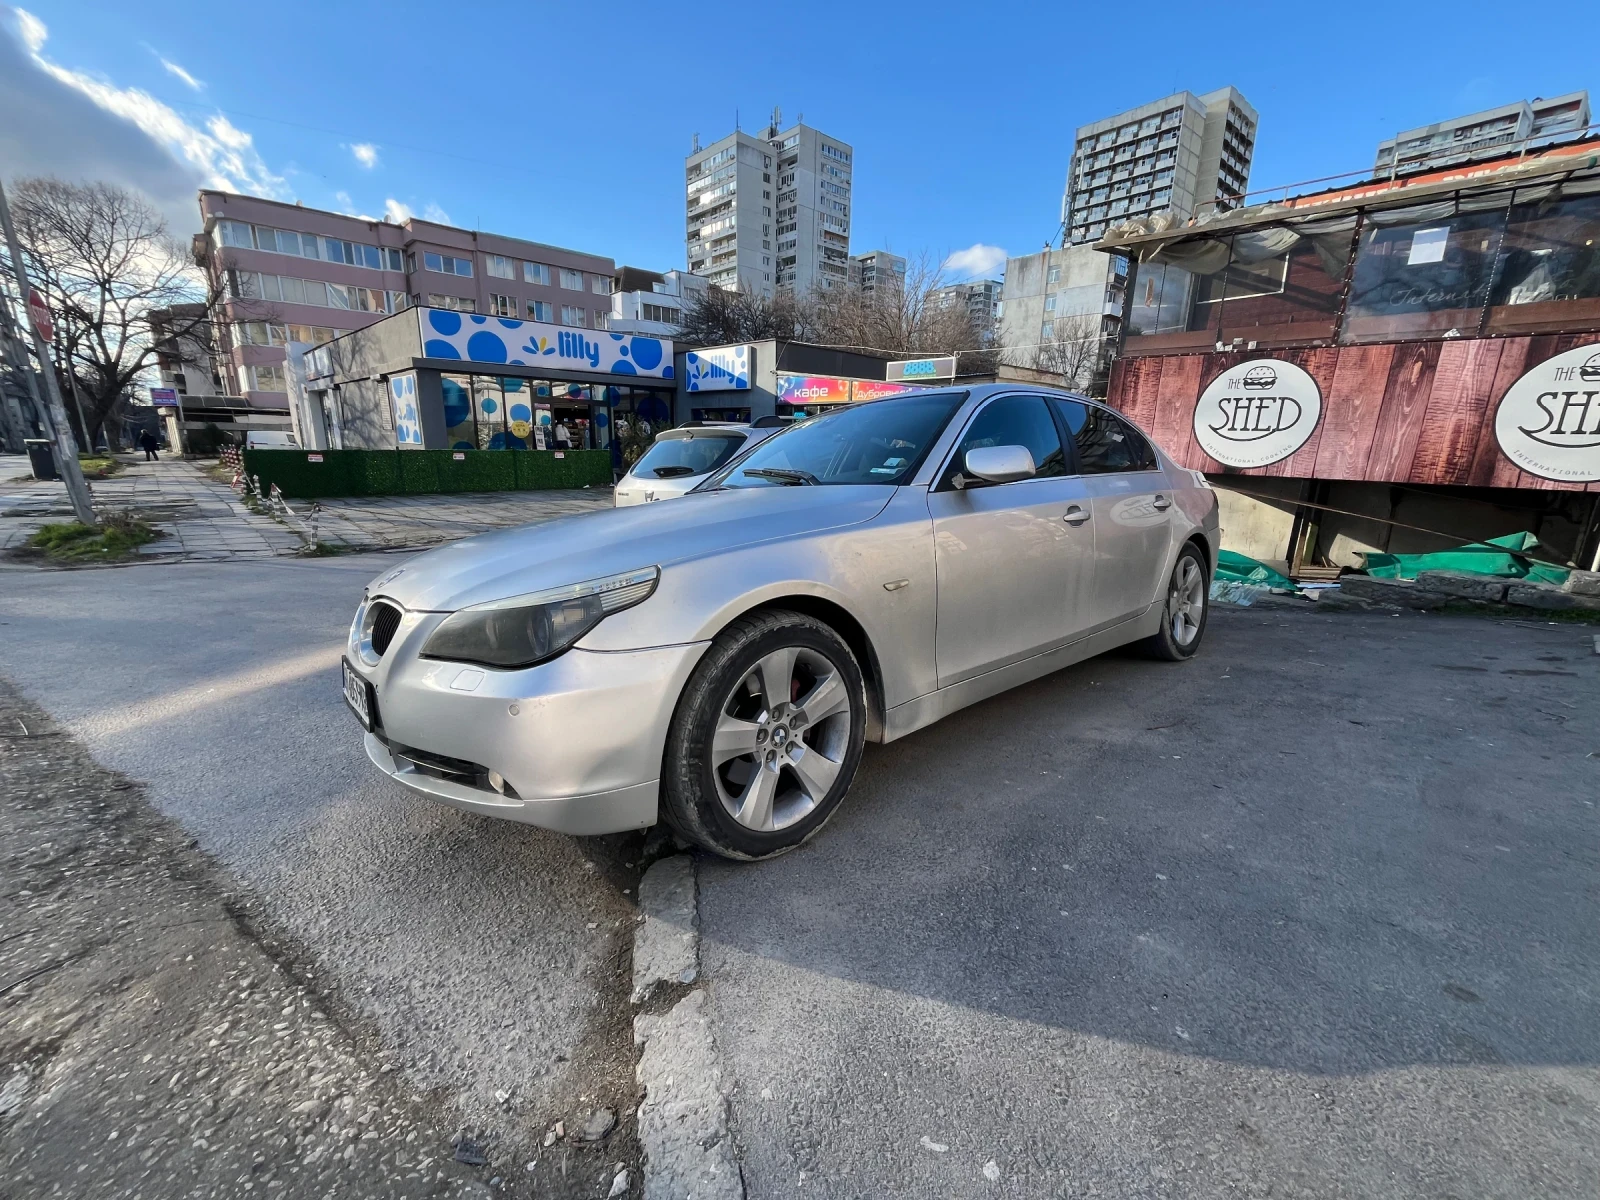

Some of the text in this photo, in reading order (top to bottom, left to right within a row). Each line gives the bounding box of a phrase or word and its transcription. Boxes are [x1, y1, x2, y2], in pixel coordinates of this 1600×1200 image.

[557, 330, 600, 368] lilly
[710, 354, 736, 384] lilly
[1554, 366, 1578, 382] THE
[793, 386, 829, 401] кафе
[1227, 378, 1242, 390] THE
[1208, 396, 1302, 442] SHED
[1206, 442, 1293, 464] INTERNATIONAL COOKING
[1513, 449, 1594, 476] INTERNATIONAL
